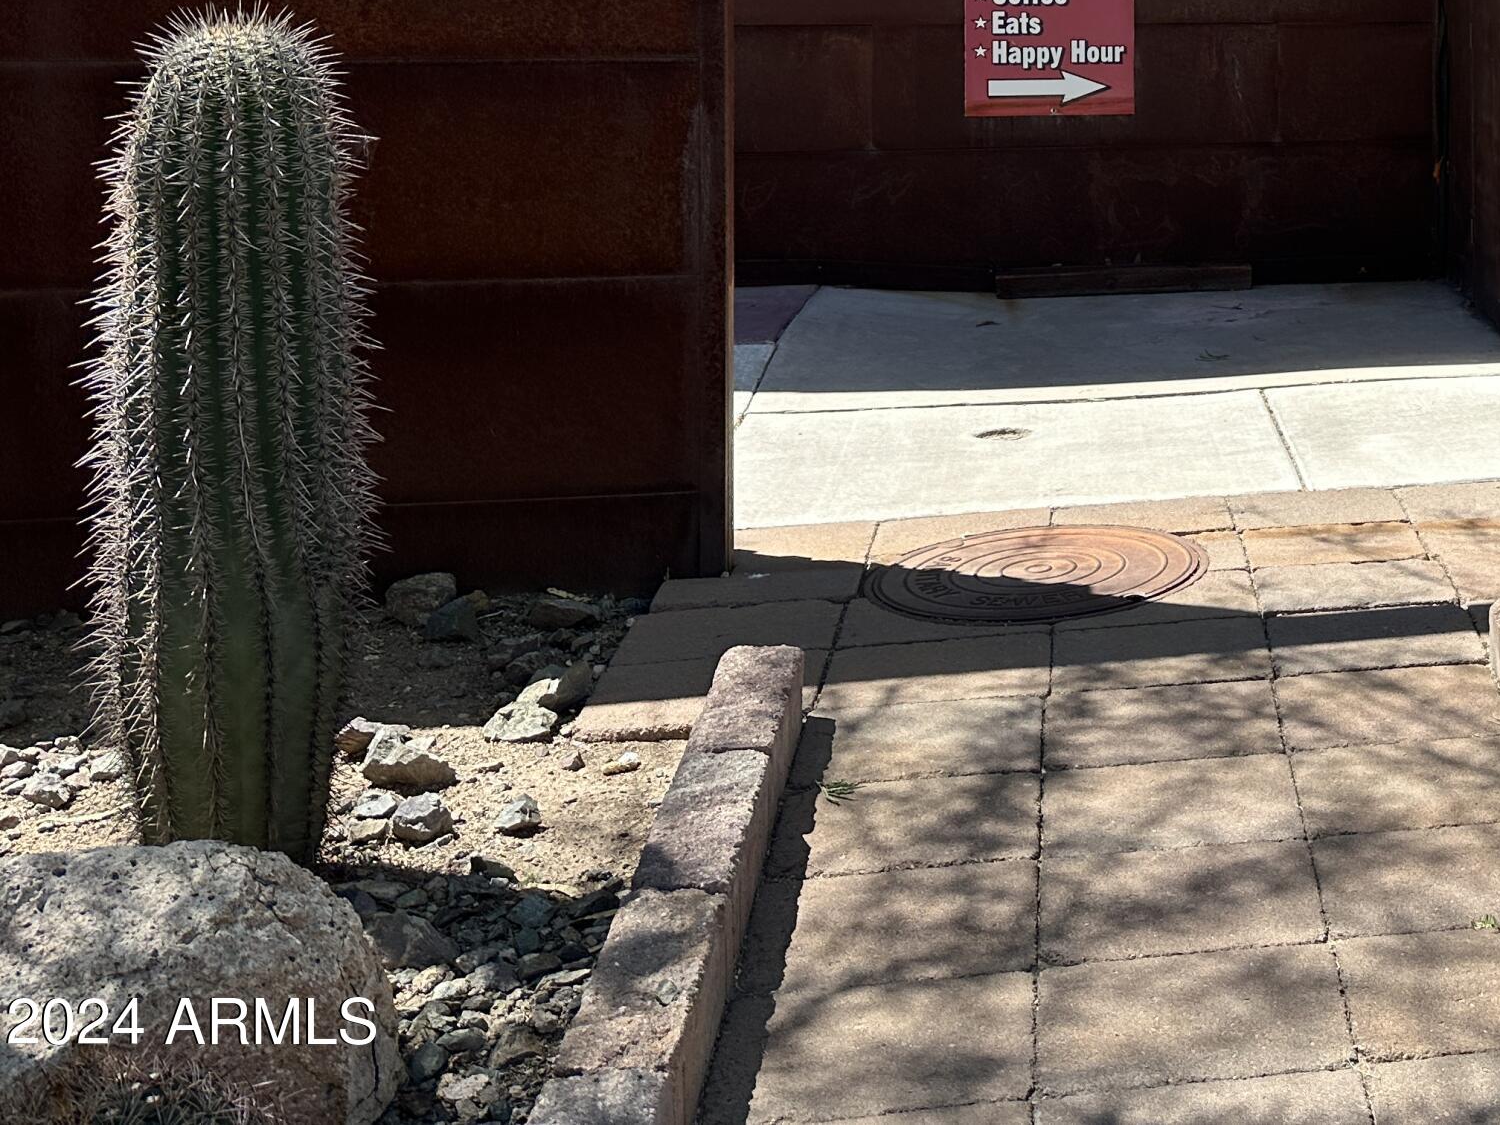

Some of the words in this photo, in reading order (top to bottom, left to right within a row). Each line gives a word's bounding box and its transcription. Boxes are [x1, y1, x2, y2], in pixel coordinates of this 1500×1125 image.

[991, 11, 1041, 35] Eats
[991, 40, 1063, 69] Happy
[1071, 39, 1125, 64] Hour
[970, 591, 1083, 606] SEWER
